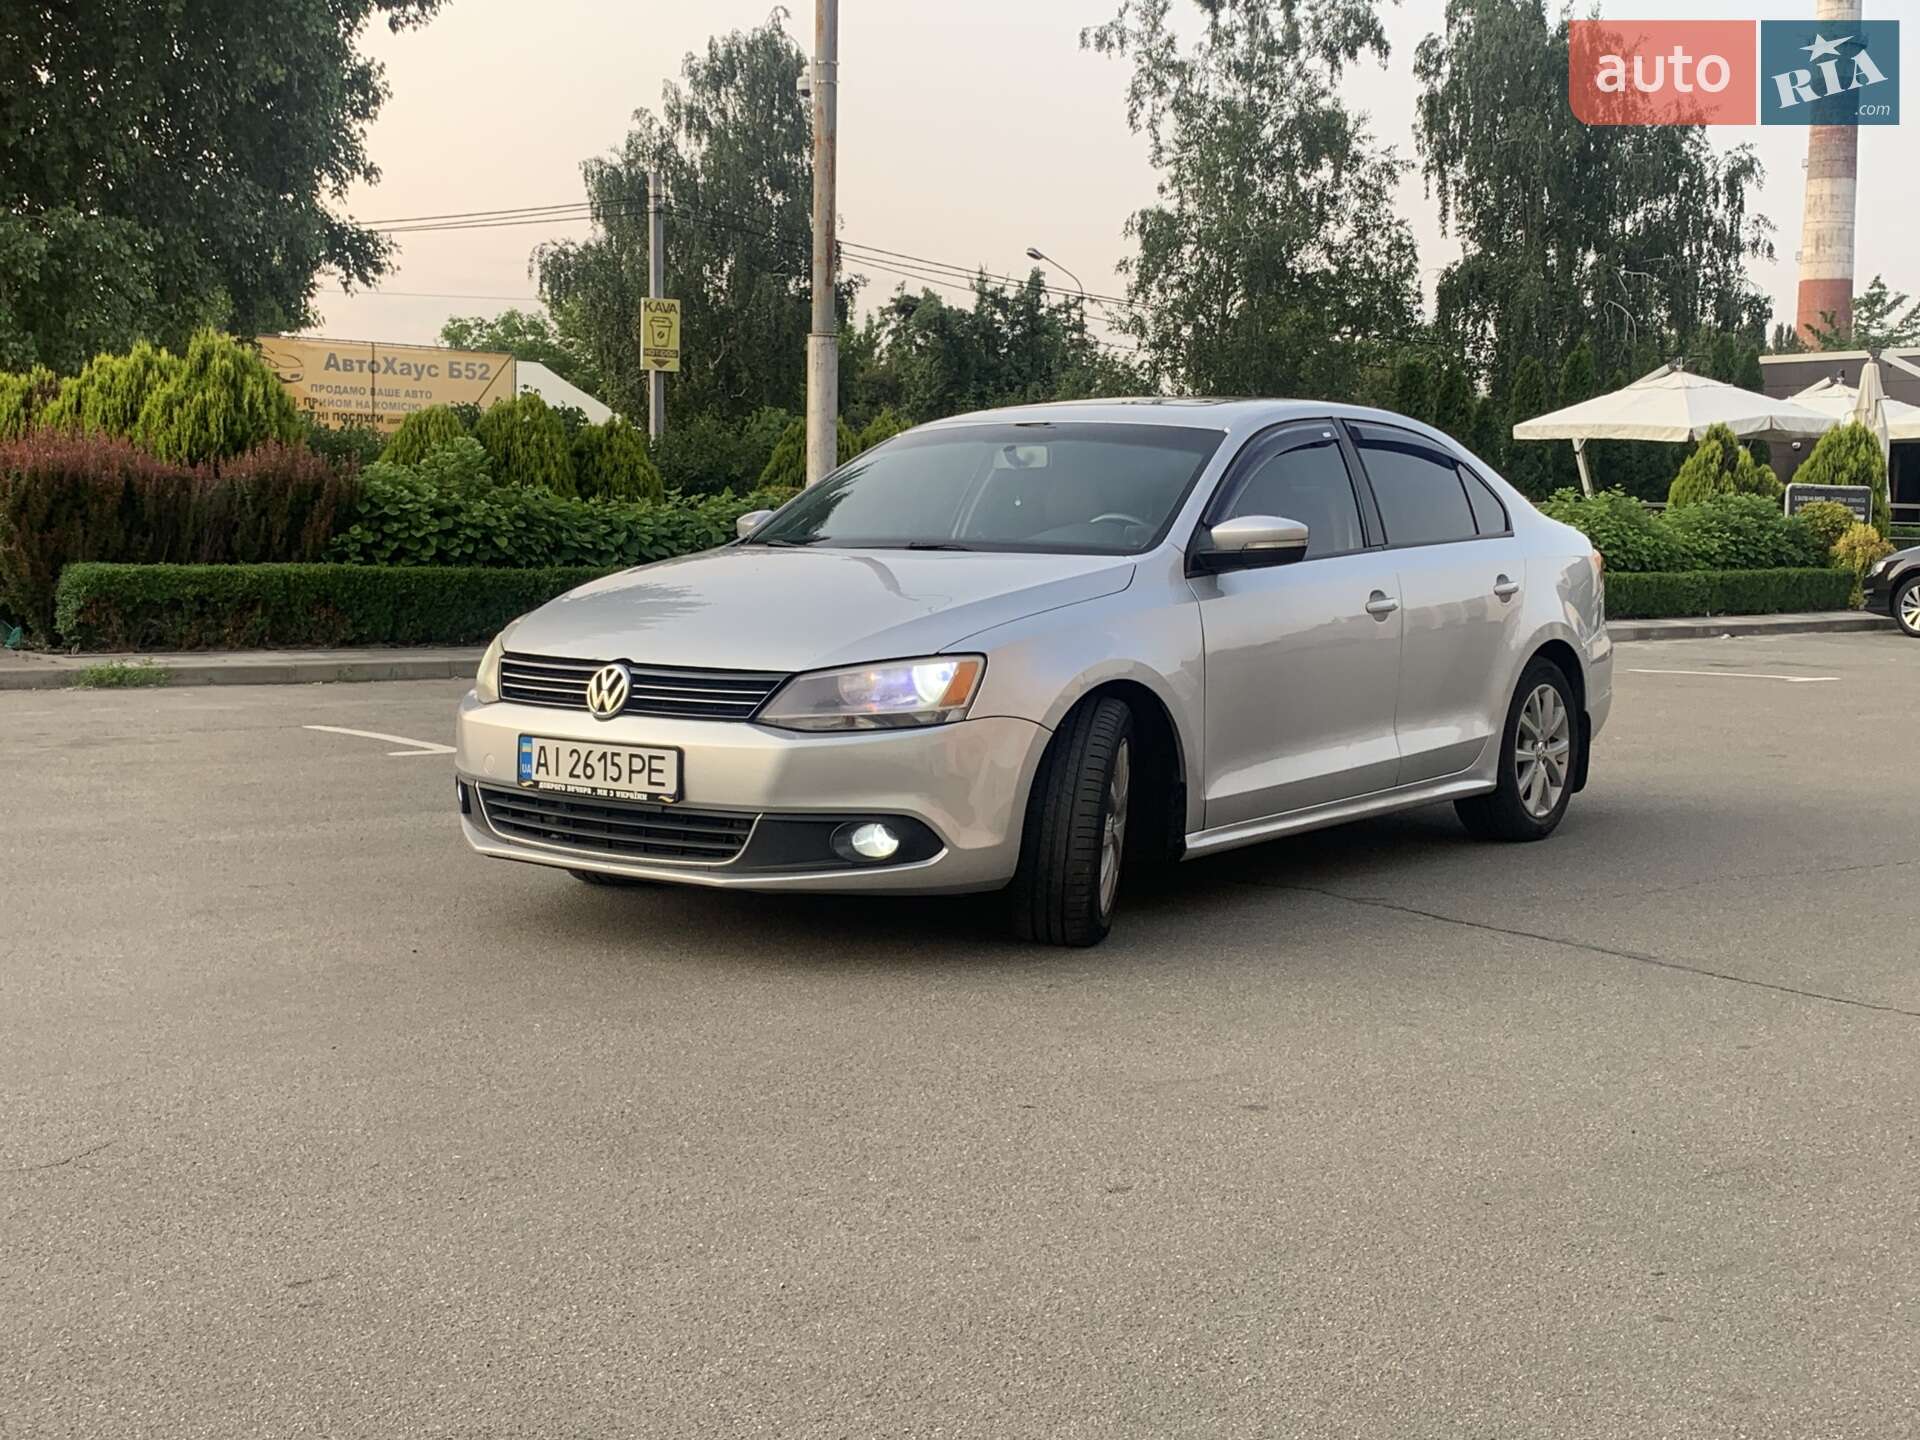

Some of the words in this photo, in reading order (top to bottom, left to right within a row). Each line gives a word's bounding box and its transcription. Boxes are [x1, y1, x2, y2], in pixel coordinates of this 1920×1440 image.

[324, 352, 439, 381] АвтоХаус
[448, 361, 491, 381] Б52
[311, 384, 366, 396] ПРОДАМО
[371, 387, 400, 398] ВАШЕ
[404, 389, 433, 399] АВТО
[356, 401, 370, 410] НА
[333, 412, 384, 424] ПОСЛУГИ
[536, 746, 559, 777] AI
